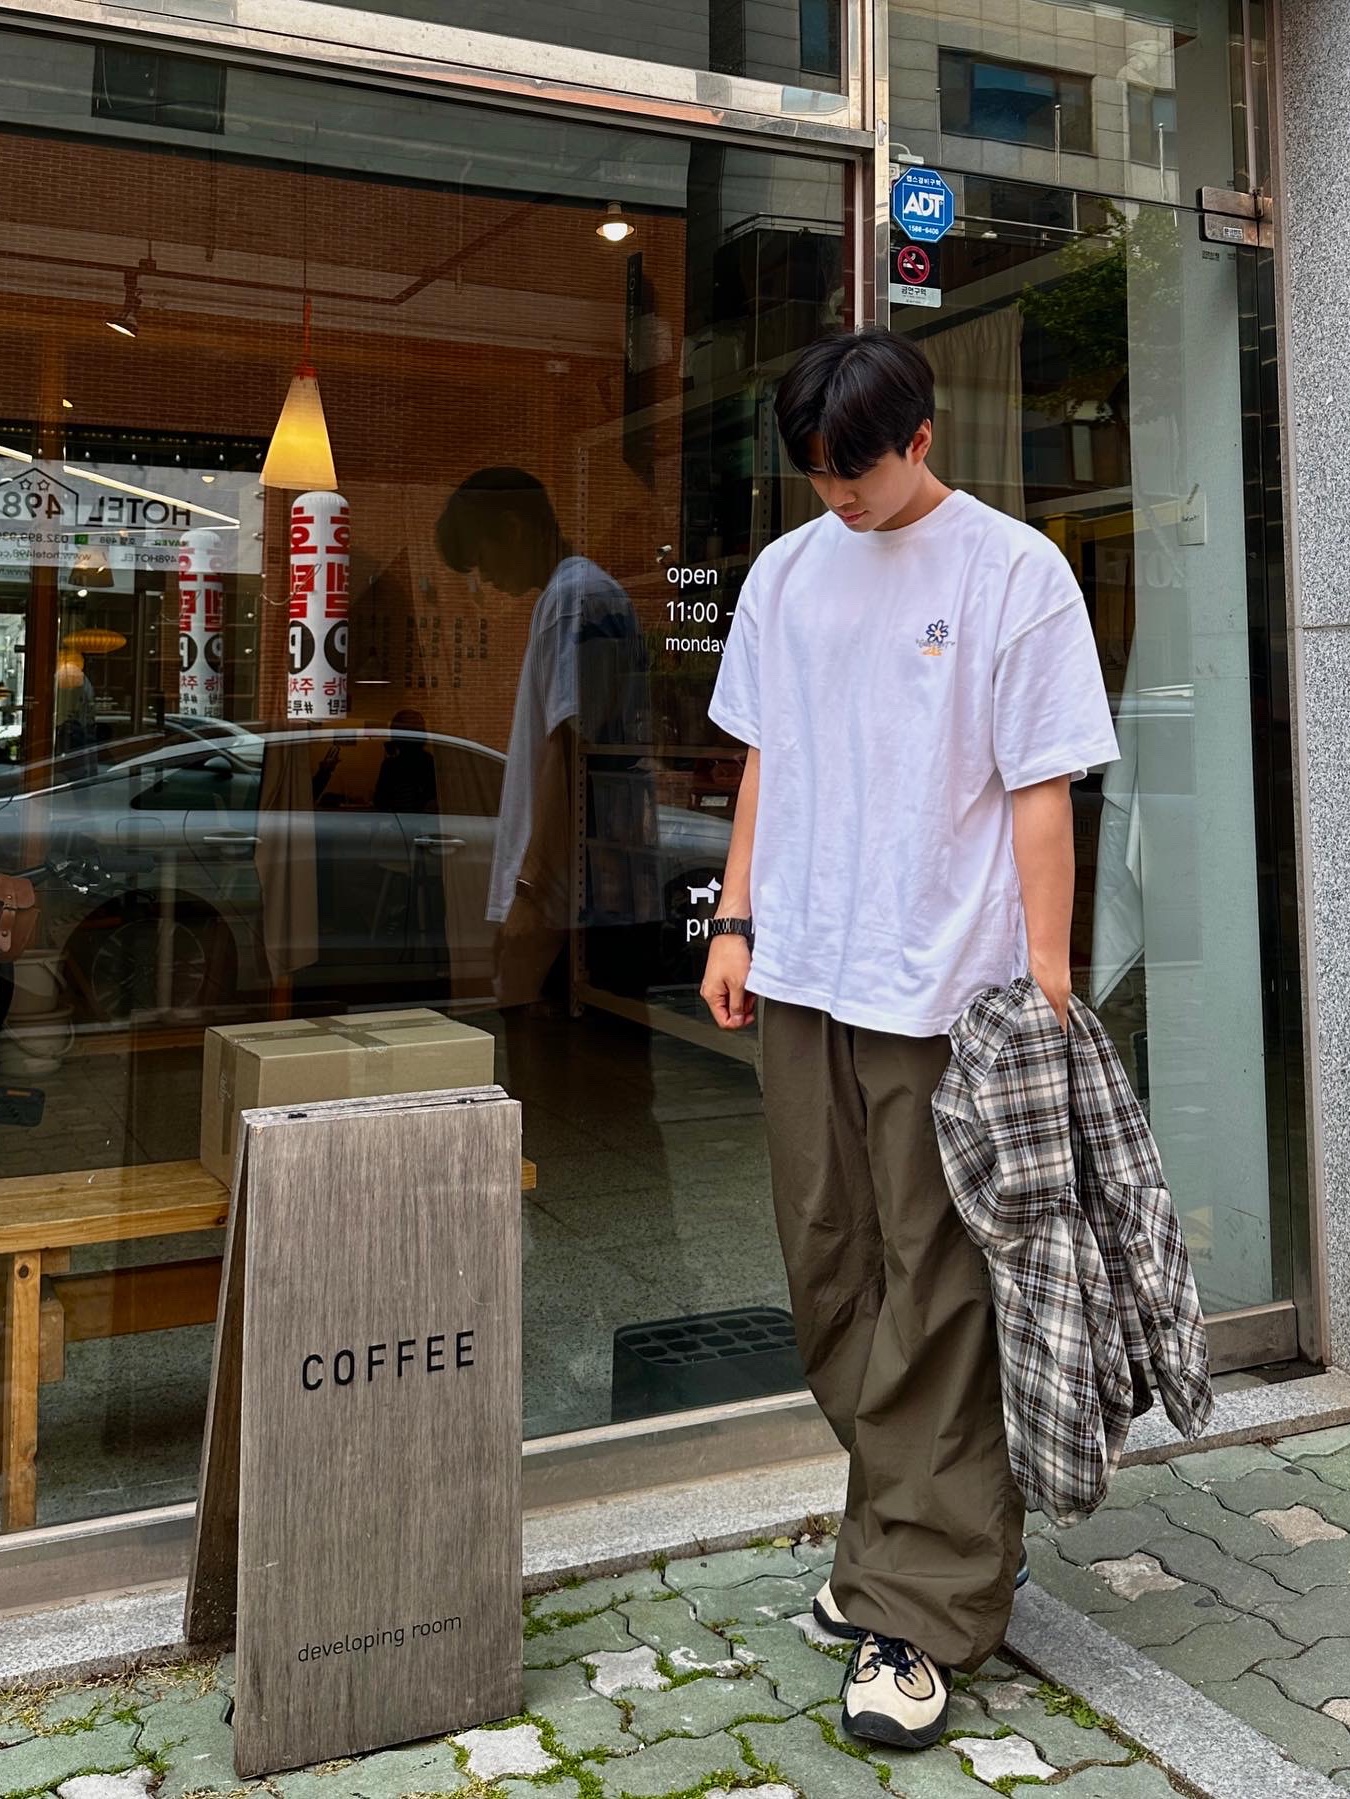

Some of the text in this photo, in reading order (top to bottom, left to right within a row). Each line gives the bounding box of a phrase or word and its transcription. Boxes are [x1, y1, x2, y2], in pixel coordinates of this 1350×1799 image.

[904, 191, 944, 219] ADT
[901, 286, 927, 296] 금연구역
[666, 567, 718, 589] open
[666, 601, 718, 623] 11:00
[302, 1330, 474, 1391] COFFEE
[298, 1616, 462, 1662] developing room
